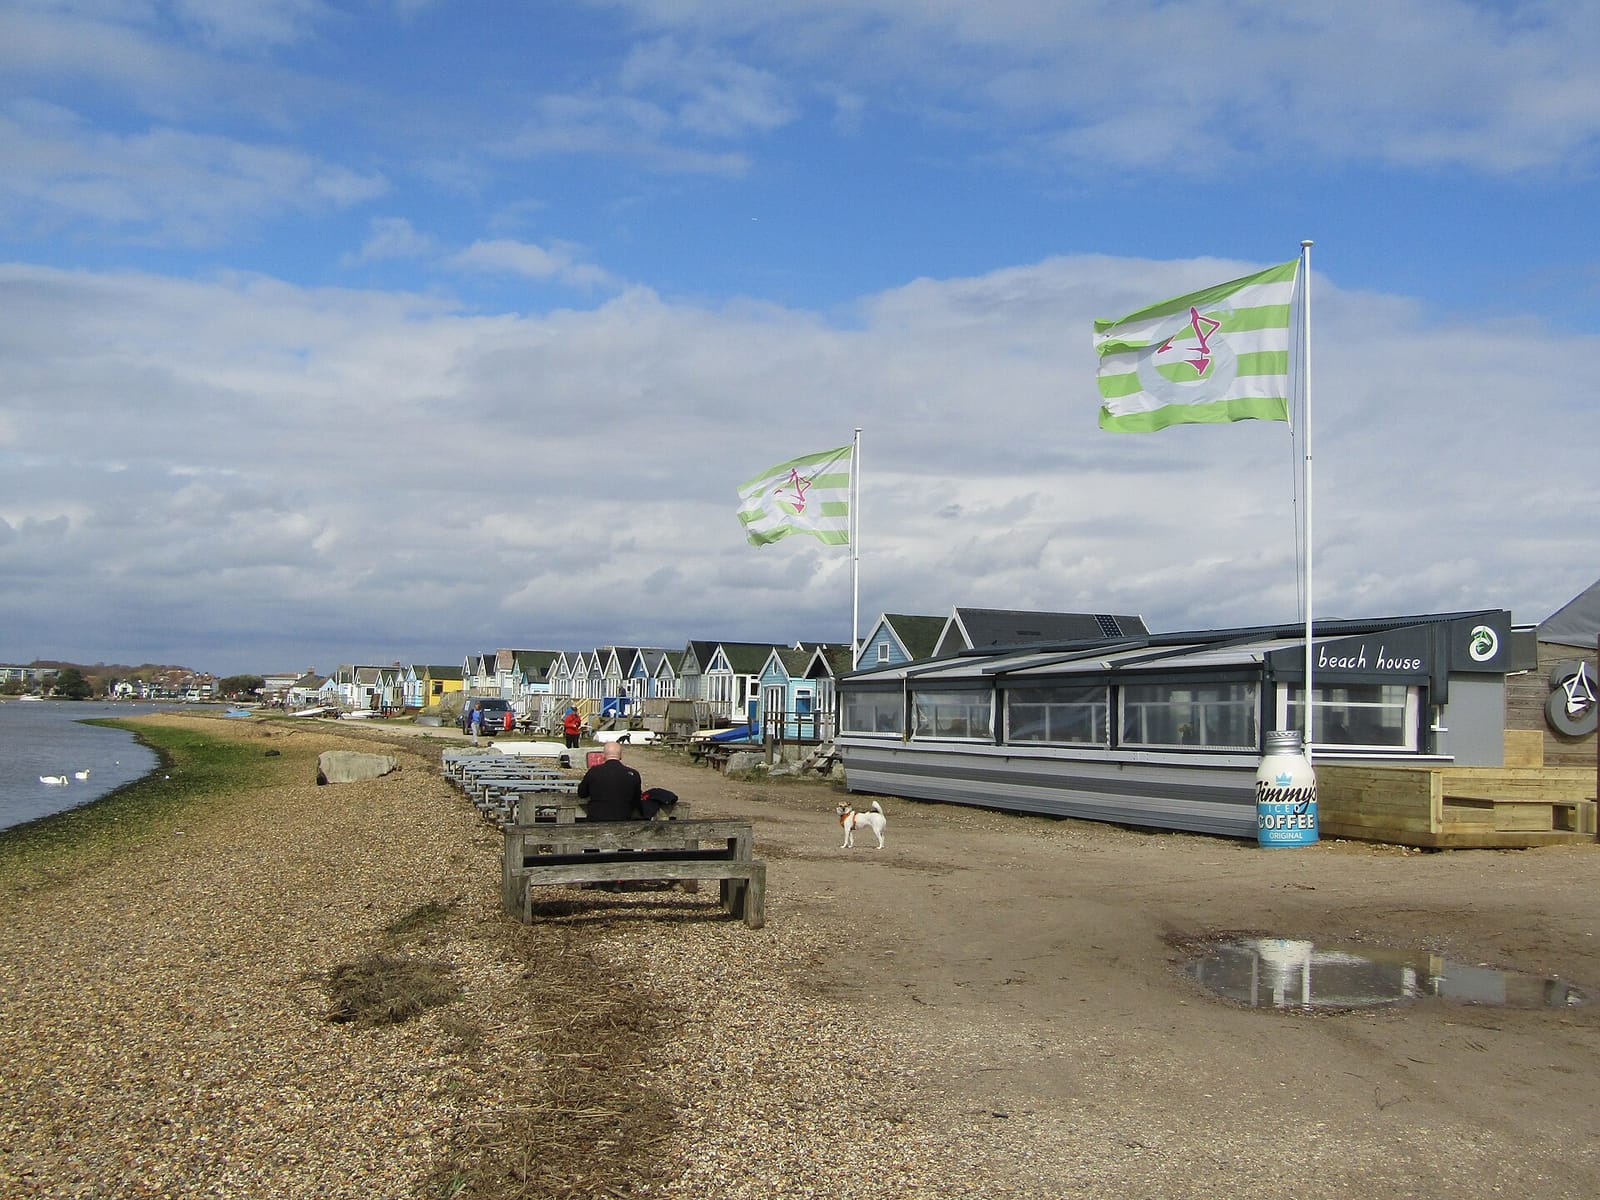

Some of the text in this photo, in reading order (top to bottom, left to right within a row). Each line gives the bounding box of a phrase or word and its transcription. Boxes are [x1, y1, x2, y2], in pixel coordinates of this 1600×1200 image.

[1318, 644, 1421, 670] beach house
[1256, 779, 1317, 815] Jimmy's
[1268, 804, 1301, 813] ICED
[1258, 814, 1315, 830] COFFEE
[1269, 832, 1303, 840] ORIGINAL
